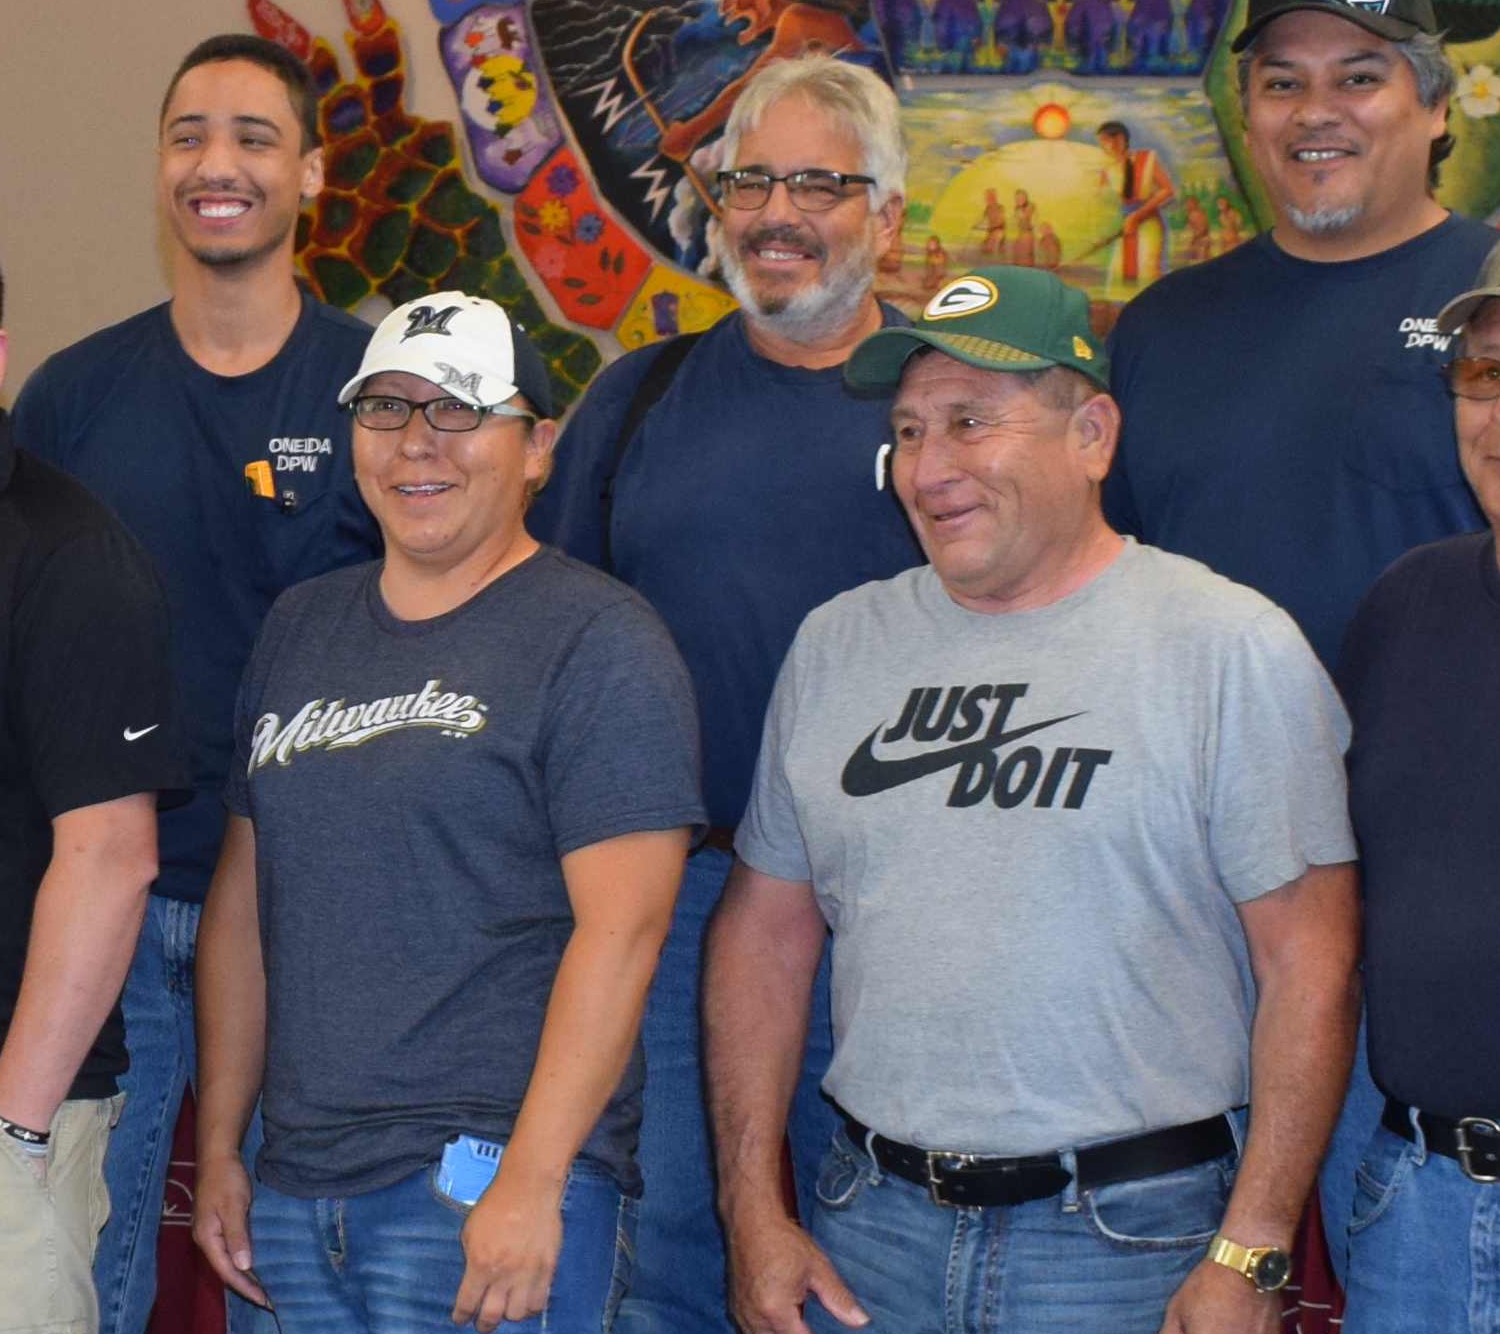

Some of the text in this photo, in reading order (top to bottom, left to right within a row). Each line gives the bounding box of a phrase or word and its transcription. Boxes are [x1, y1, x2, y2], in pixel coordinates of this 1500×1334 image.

[924, 276, 998, 321] G
[400, 305, 464, 344] M
[1404, 332, 1453, 353] DPW
[268, 437, 333, 455] ONEIDA
[275, 455, 319, 472] DPW
[246, 678, 486, 780] Milwaukee
[880, 682, 1030, 744] JUST
